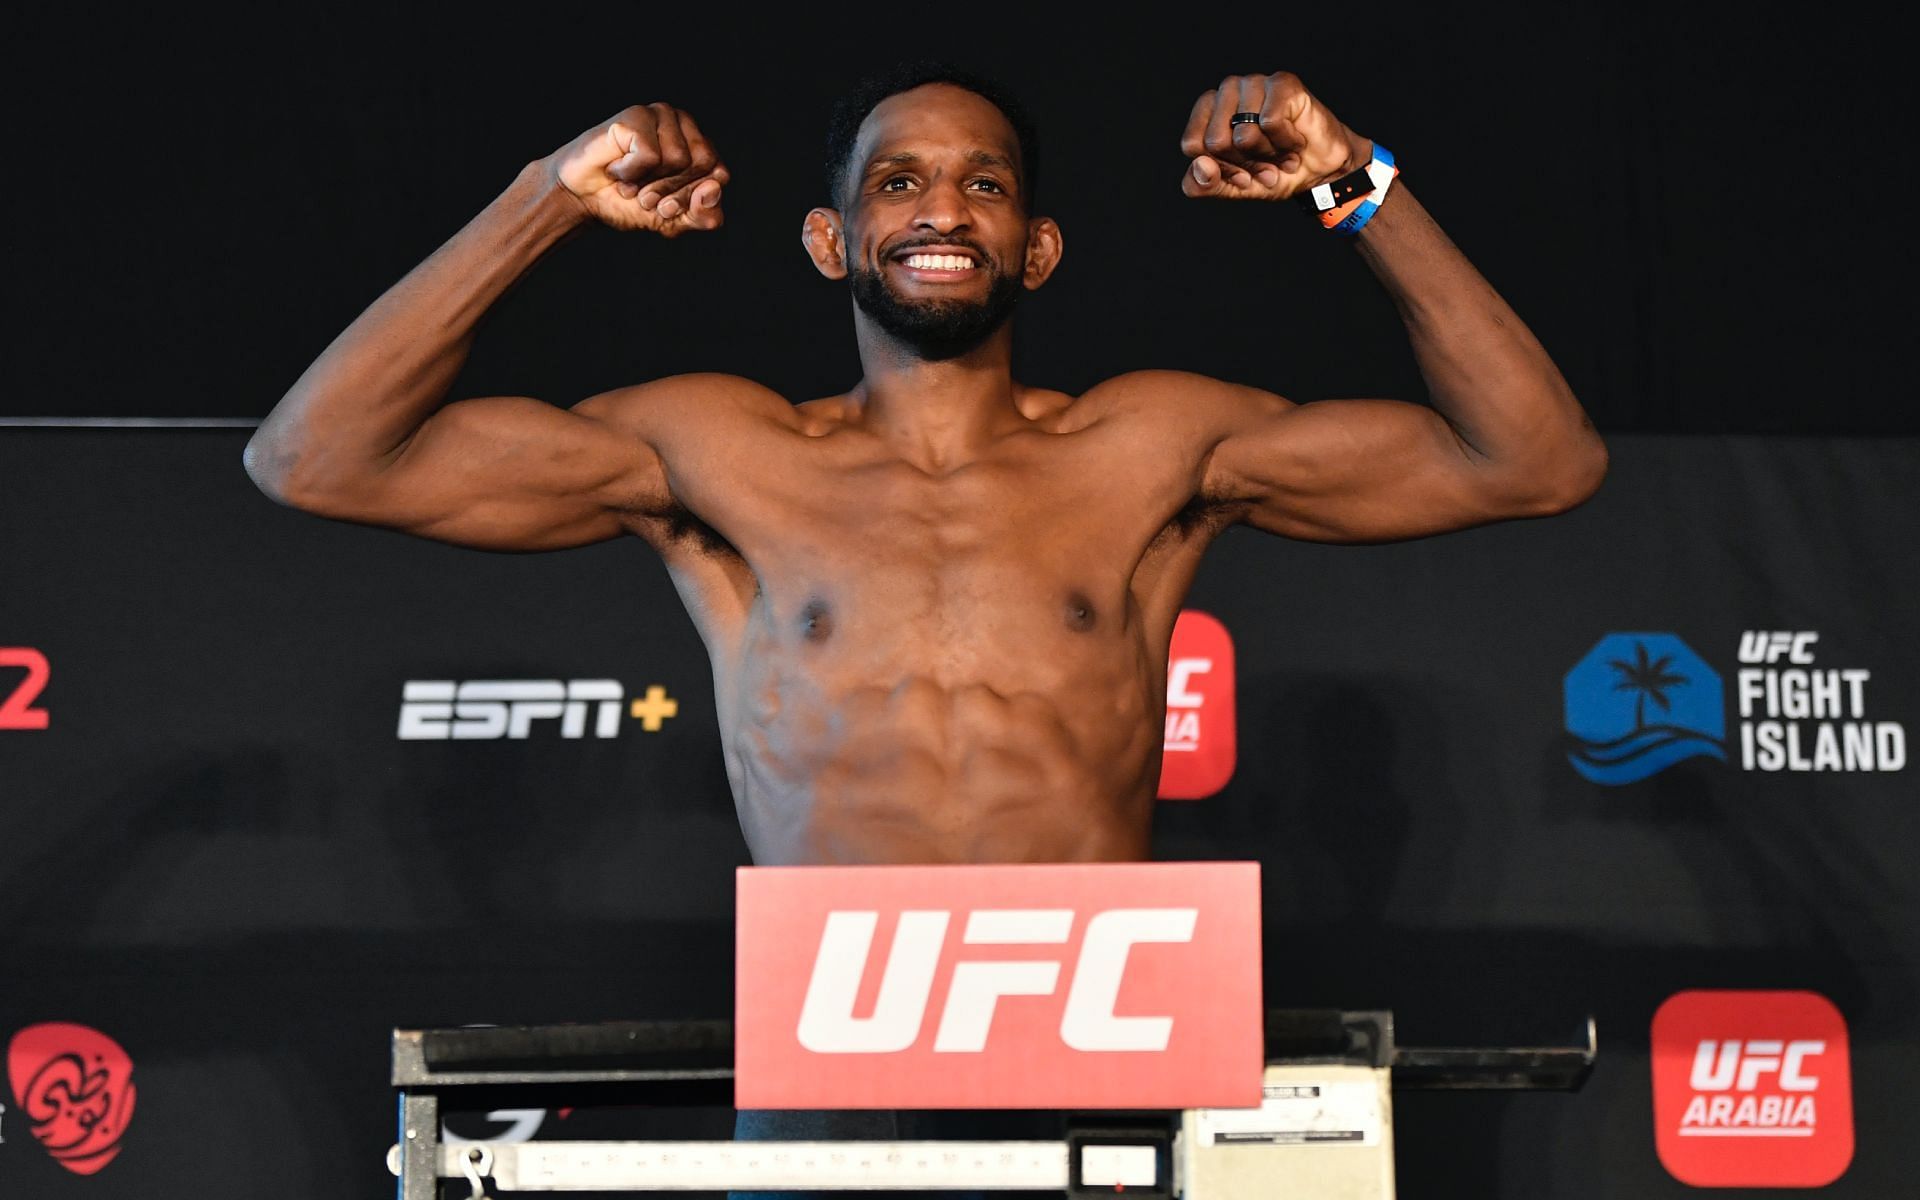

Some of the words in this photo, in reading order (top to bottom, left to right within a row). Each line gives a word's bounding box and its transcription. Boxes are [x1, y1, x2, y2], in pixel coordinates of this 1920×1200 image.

[1738, 630, 1819, 665] UFC
[1738, 669, 1871, 719] FIGHT
[1740, 720, 1907, 772] ISLAND
[796, 907, 1199, 1054] UFC
[1689, 1040, 1827, 1092] UFC
[1680, 1095, 1817, 1127] ARABIA
